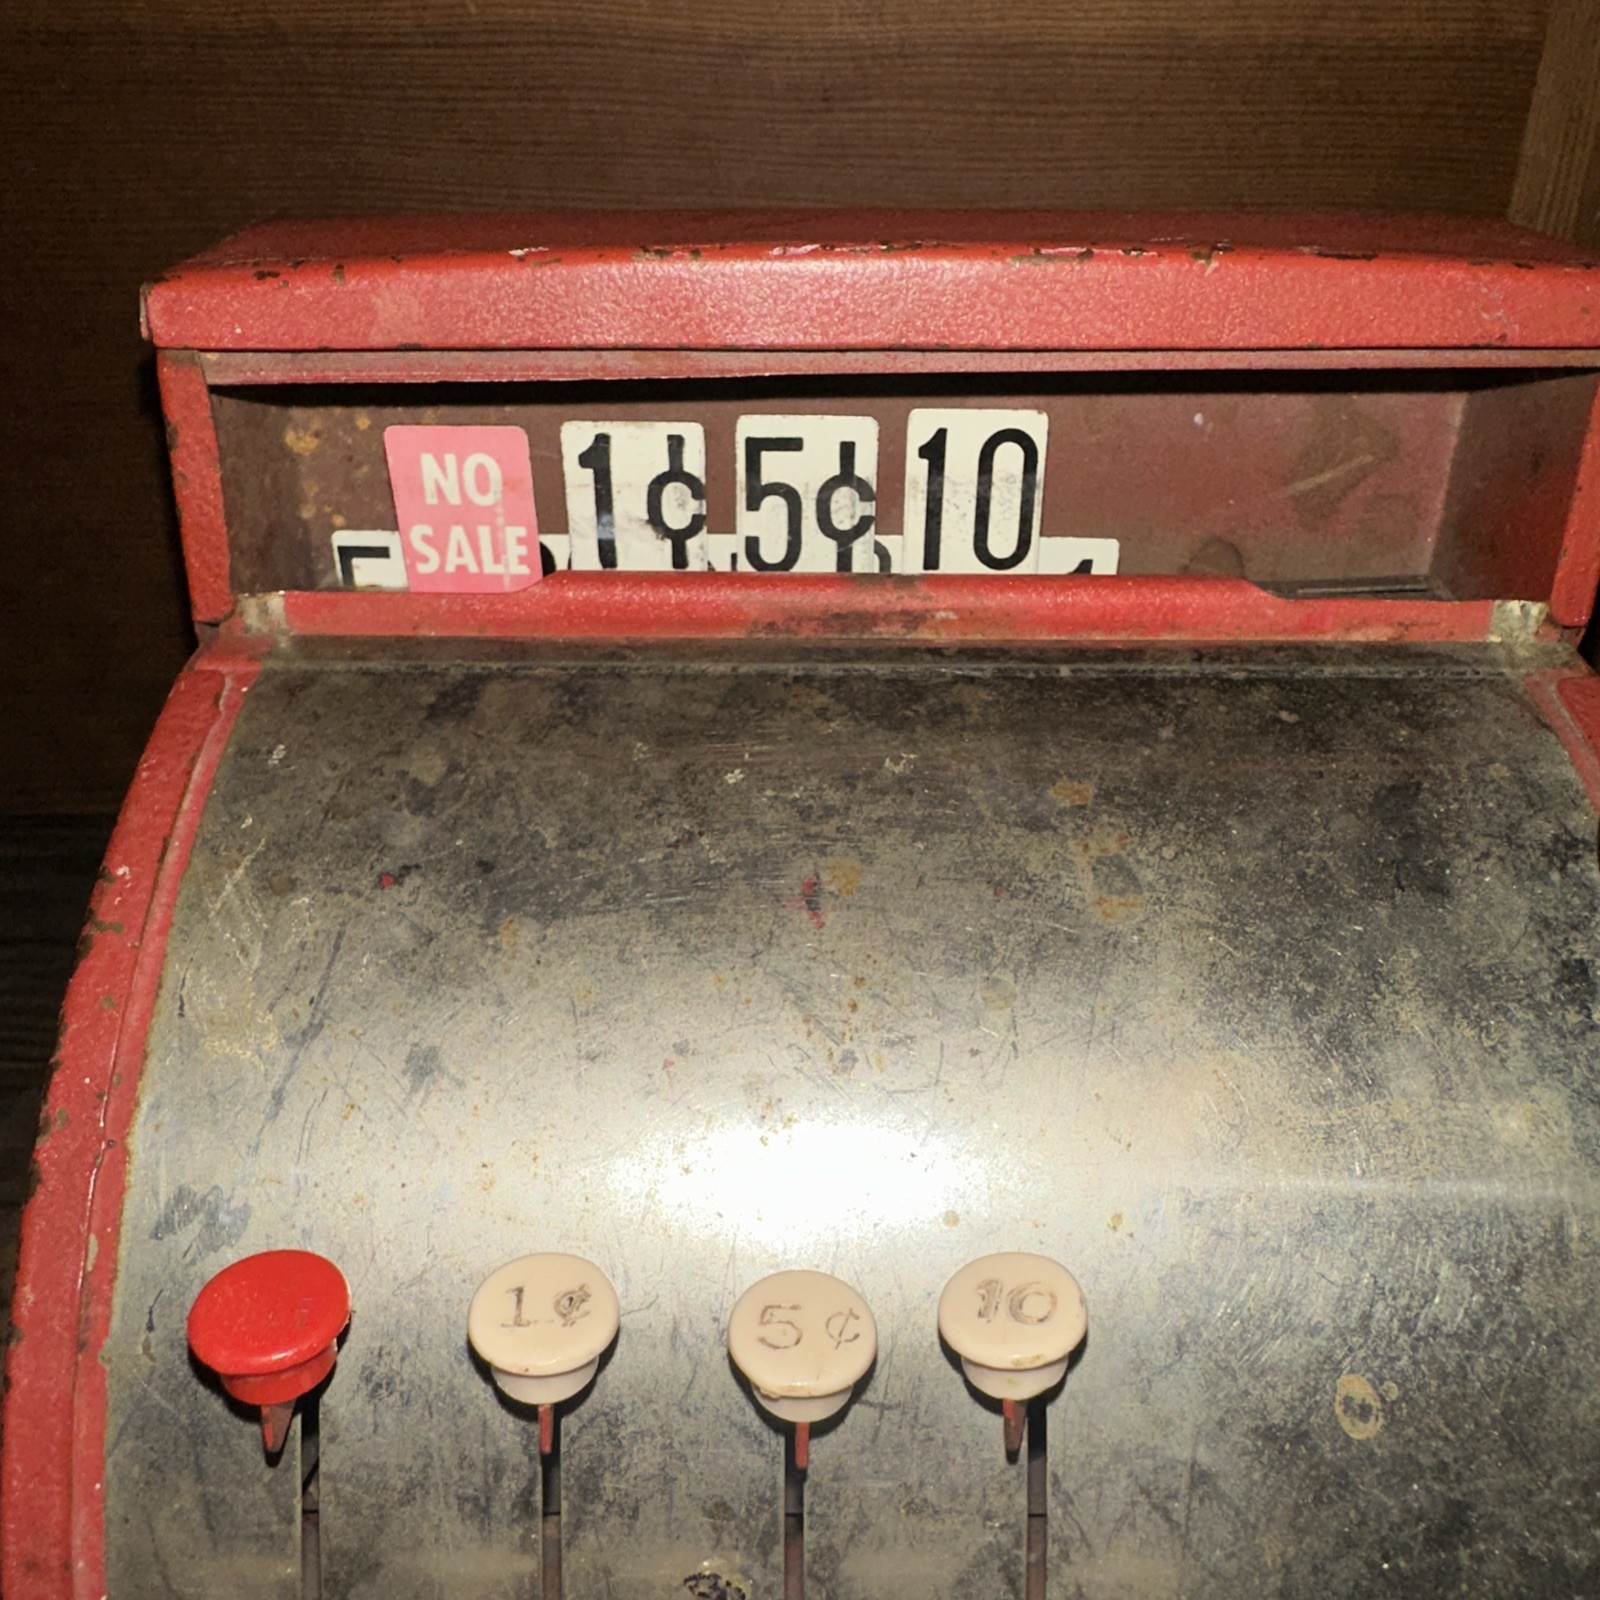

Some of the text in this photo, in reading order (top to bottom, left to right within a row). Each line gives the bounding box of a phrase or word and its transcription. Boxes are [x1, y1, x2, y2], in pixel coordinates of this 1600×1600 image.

[420, 452, 501, 506] NO
[918, 428, 1038, 570] 10
[408, 525, 531, 575] SALE
[976, 1279, 1058, 1325] 10
